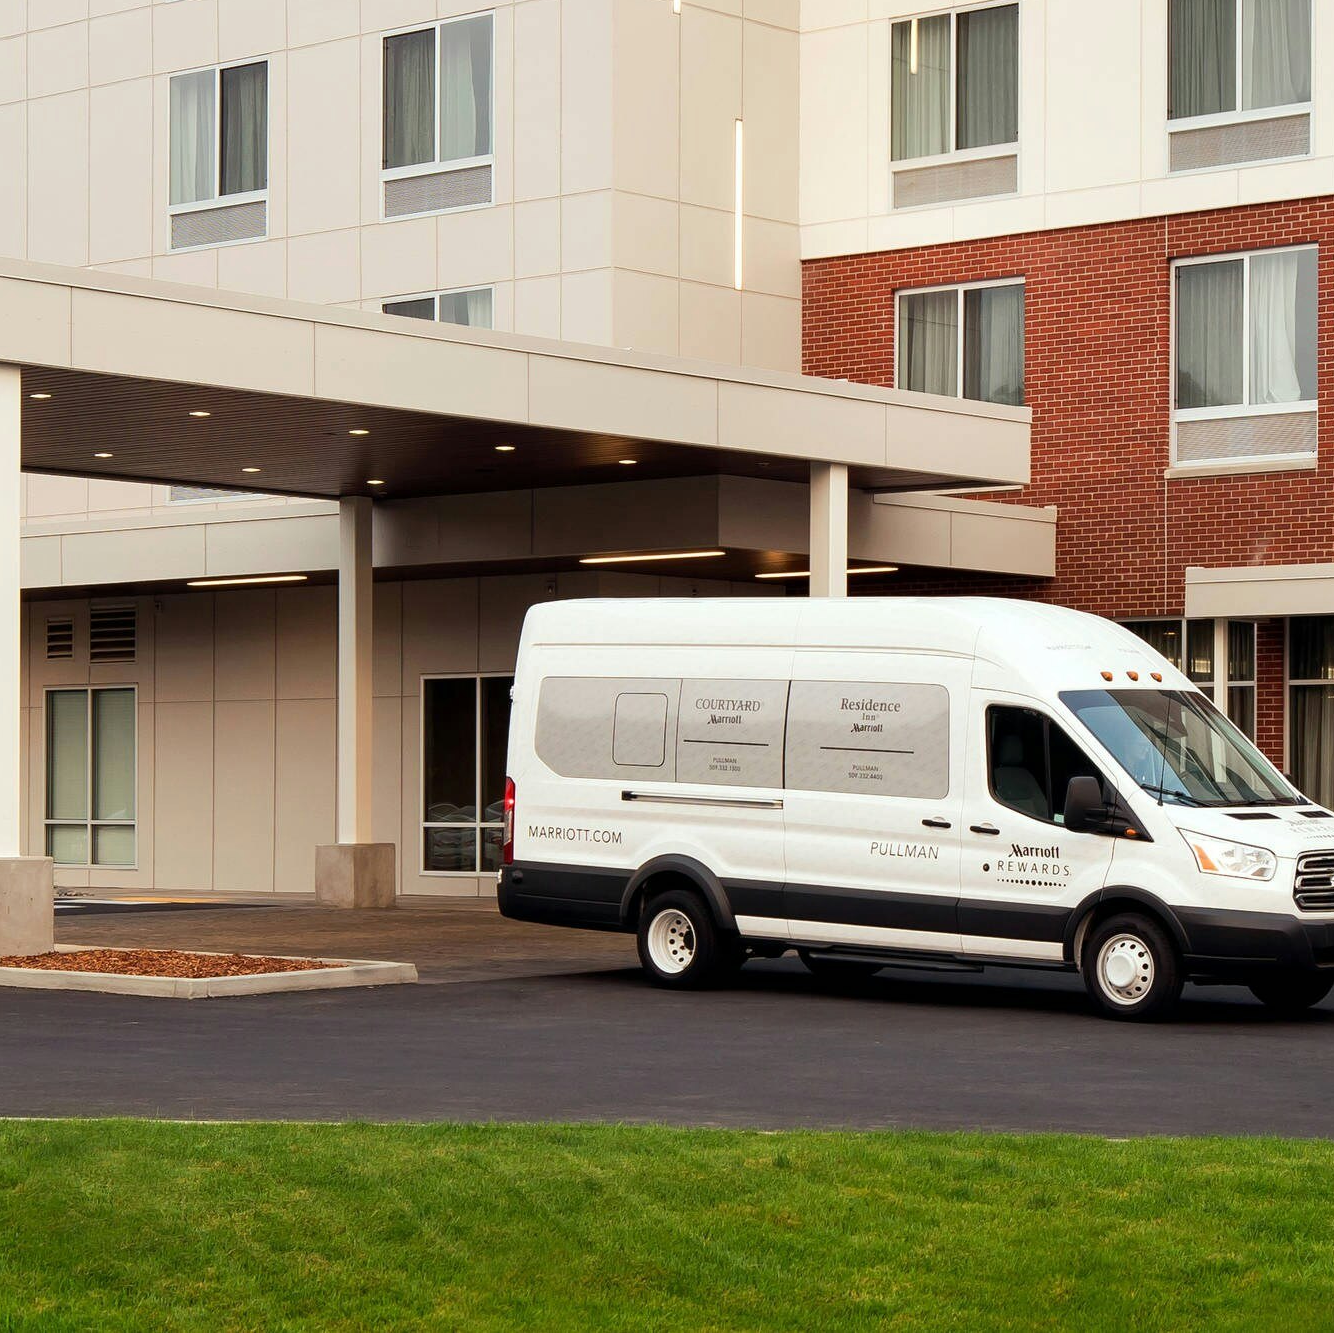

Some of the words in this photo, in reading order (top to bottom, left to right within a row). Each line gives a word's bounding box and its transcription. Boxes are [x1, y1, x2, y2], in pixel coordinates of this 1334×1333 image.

[695, 698, 761, 712] COURTYARD
[840, 698, 901, 712] Residence
[707, 714, 742, 725] Marriott
[862, 713, 876, 721] Inn
[850, 723, 883, 733] Marriott
[528, 825, 622, 844] MARRIOTT.COM
[870, 841, 939, 860] PULLMAN
[1008, 843, 1060, 859] Marriott
[997, 860, 1070, 877] REWARDS
